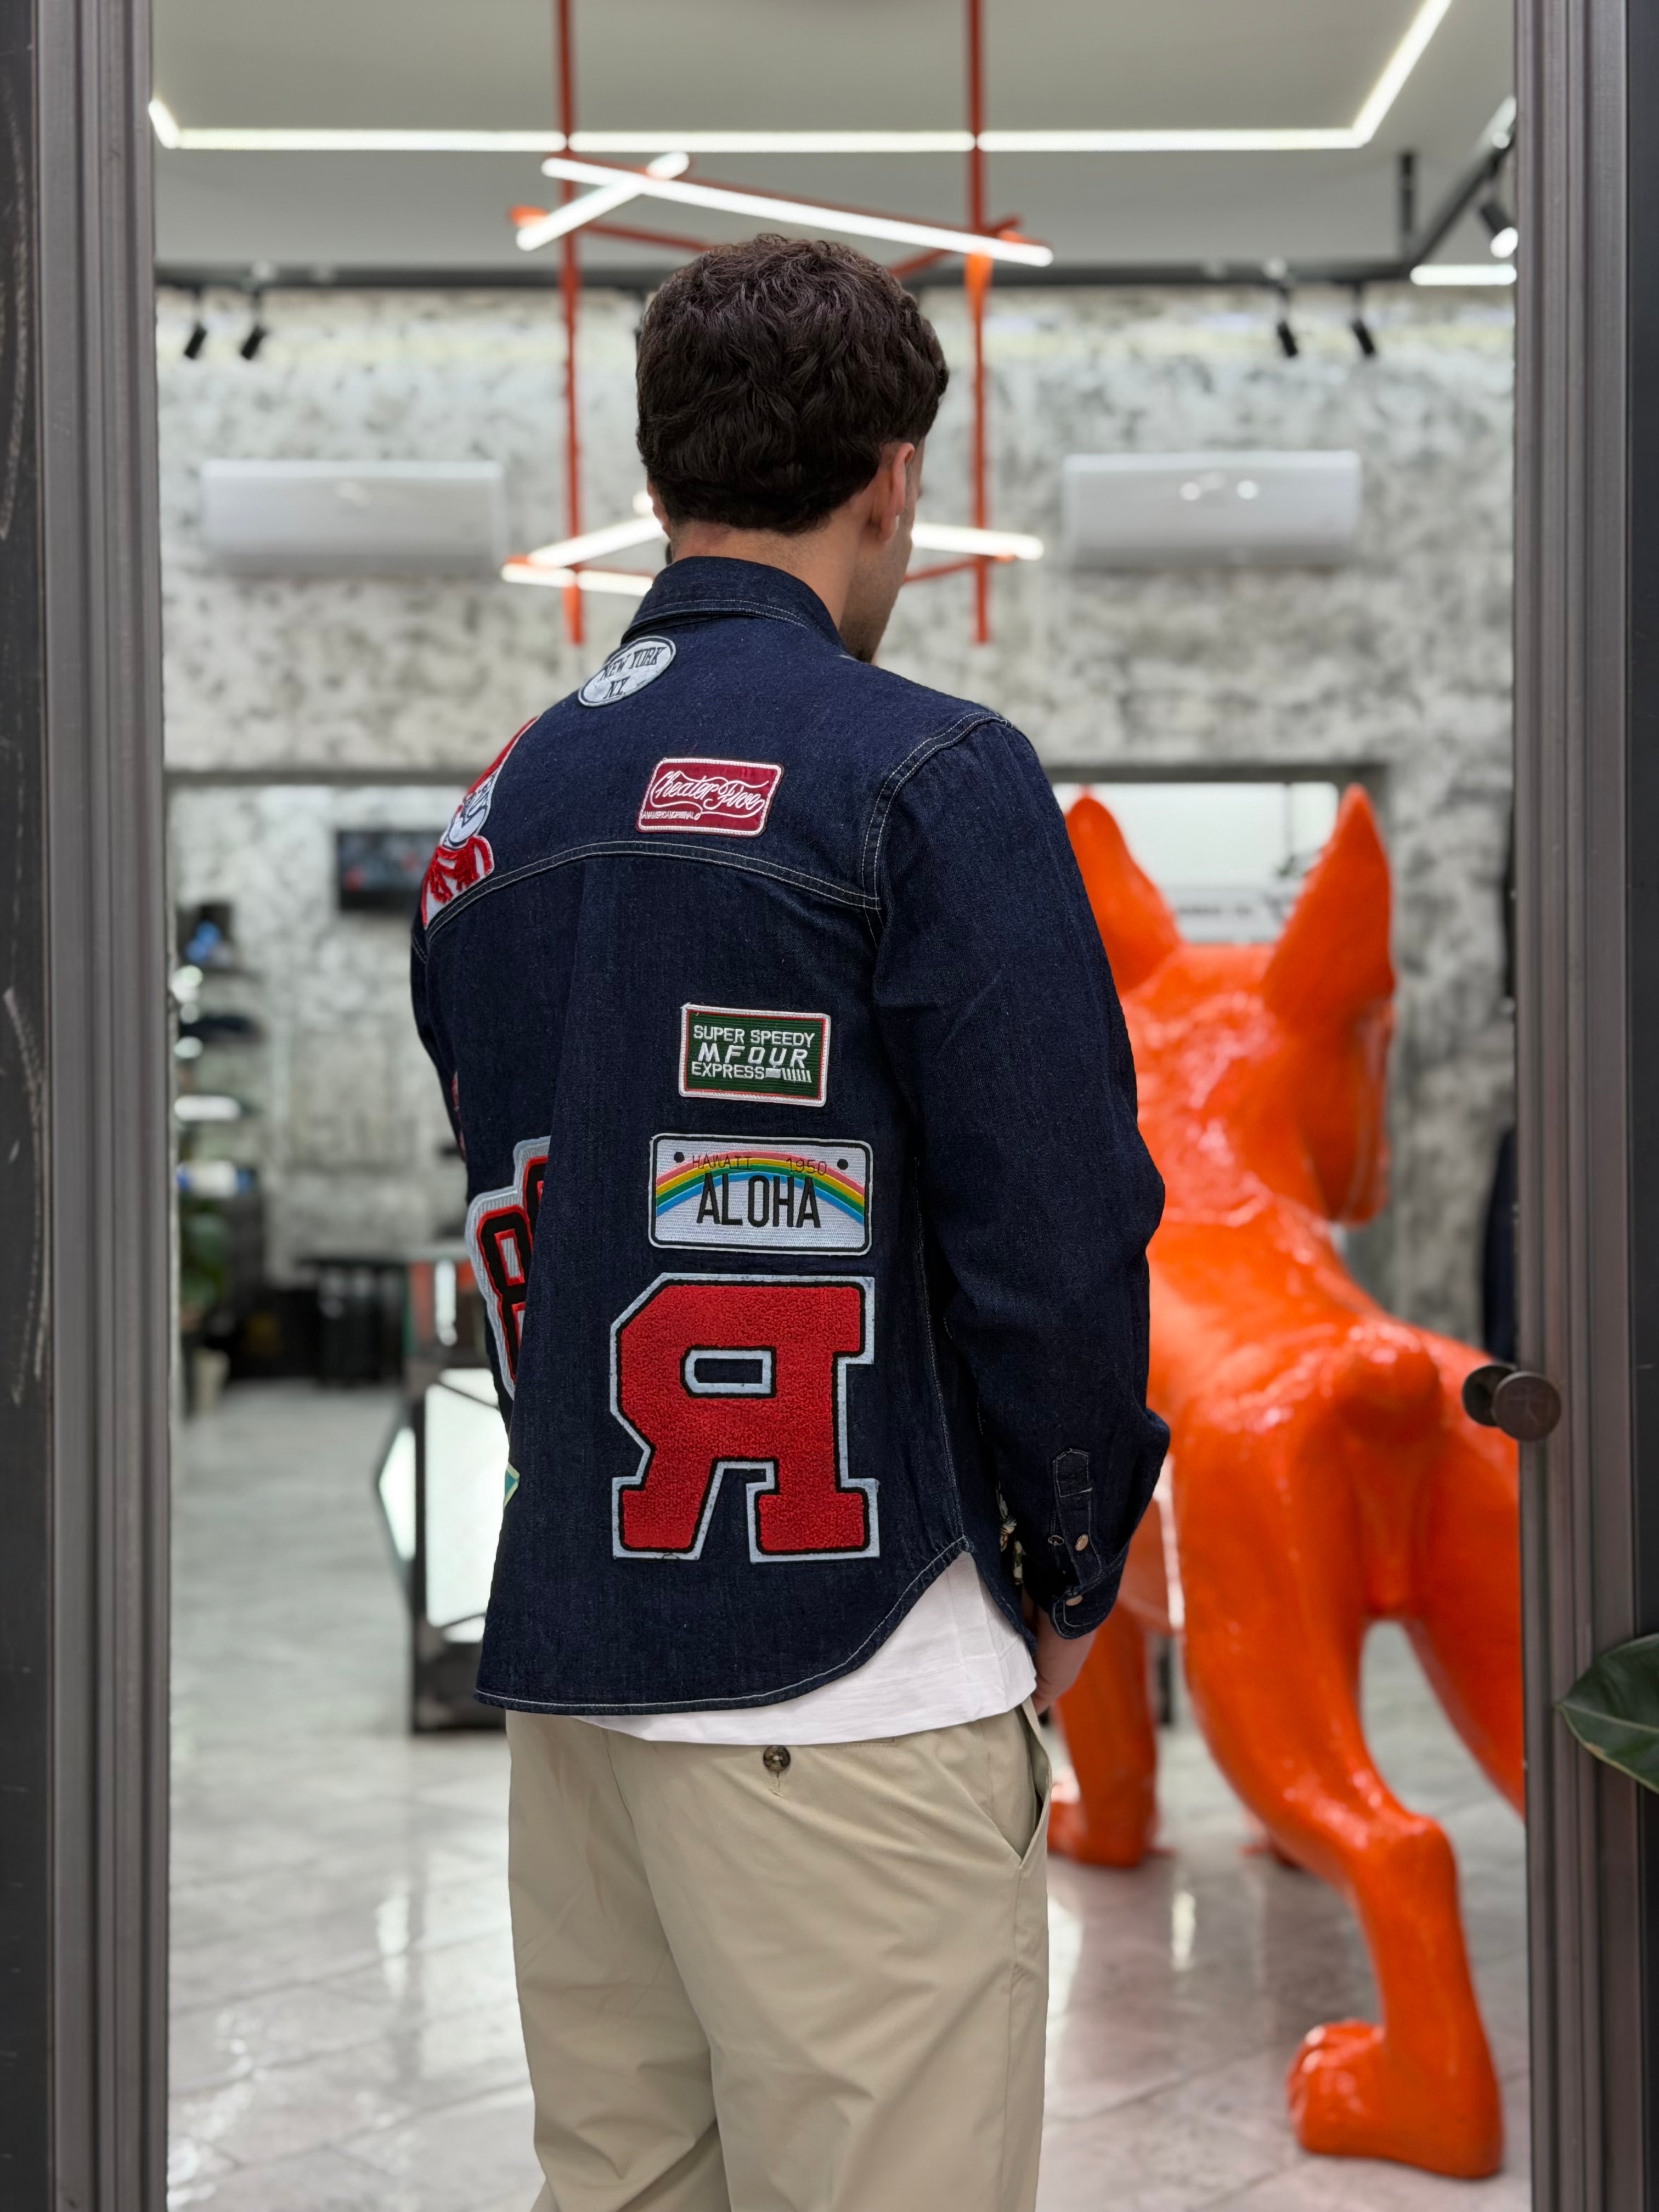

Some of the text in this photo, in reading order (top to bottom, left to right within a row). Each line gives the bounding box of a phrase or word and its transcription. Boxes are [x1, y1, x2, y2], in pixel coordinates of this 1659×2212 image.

[597, 646, 668, 682] NEW YORK
[693, 1025, 815, 1048] SUPER SPEEDY
[691, 1061, 765, 1080] EXPRESS
[692, 1154, 827, 1176] HAWAII 1950
[696, 1172, 821, 1228] ALOHA
